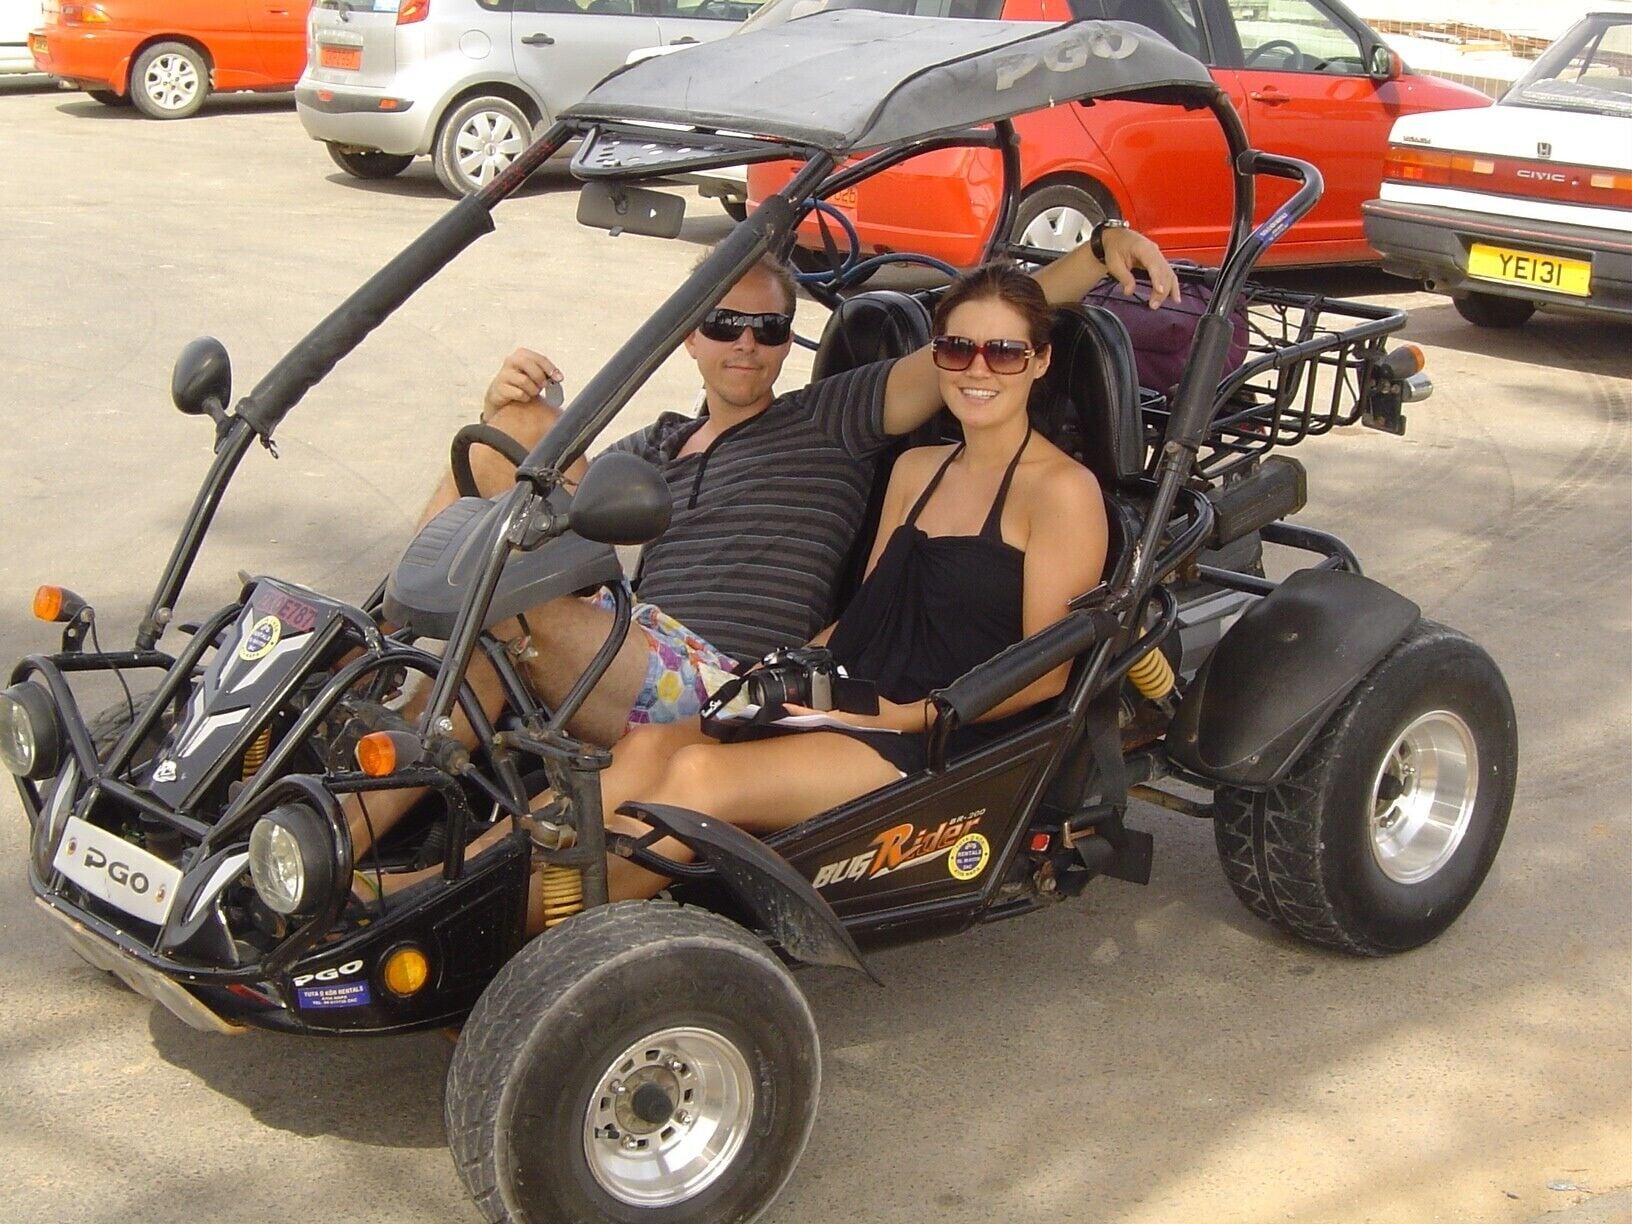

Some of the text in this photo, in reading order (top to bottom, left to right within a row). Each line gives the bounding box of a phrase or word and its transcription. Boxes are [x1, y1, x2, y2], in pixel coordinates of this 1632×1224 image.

[996, 24, 1139, 91] PGO
[1516, 169, 1567, 183] CIVIC
[1499, 253, 1563, 286] YE131
[949, 808, 986, 825] BR-200
[812, 818, 981, 889] BUG Rider
[84, 846, 150, 895] PGO
[292, 959, 364, 987] PGO
[338, 985, 364, 995] RENTALS
